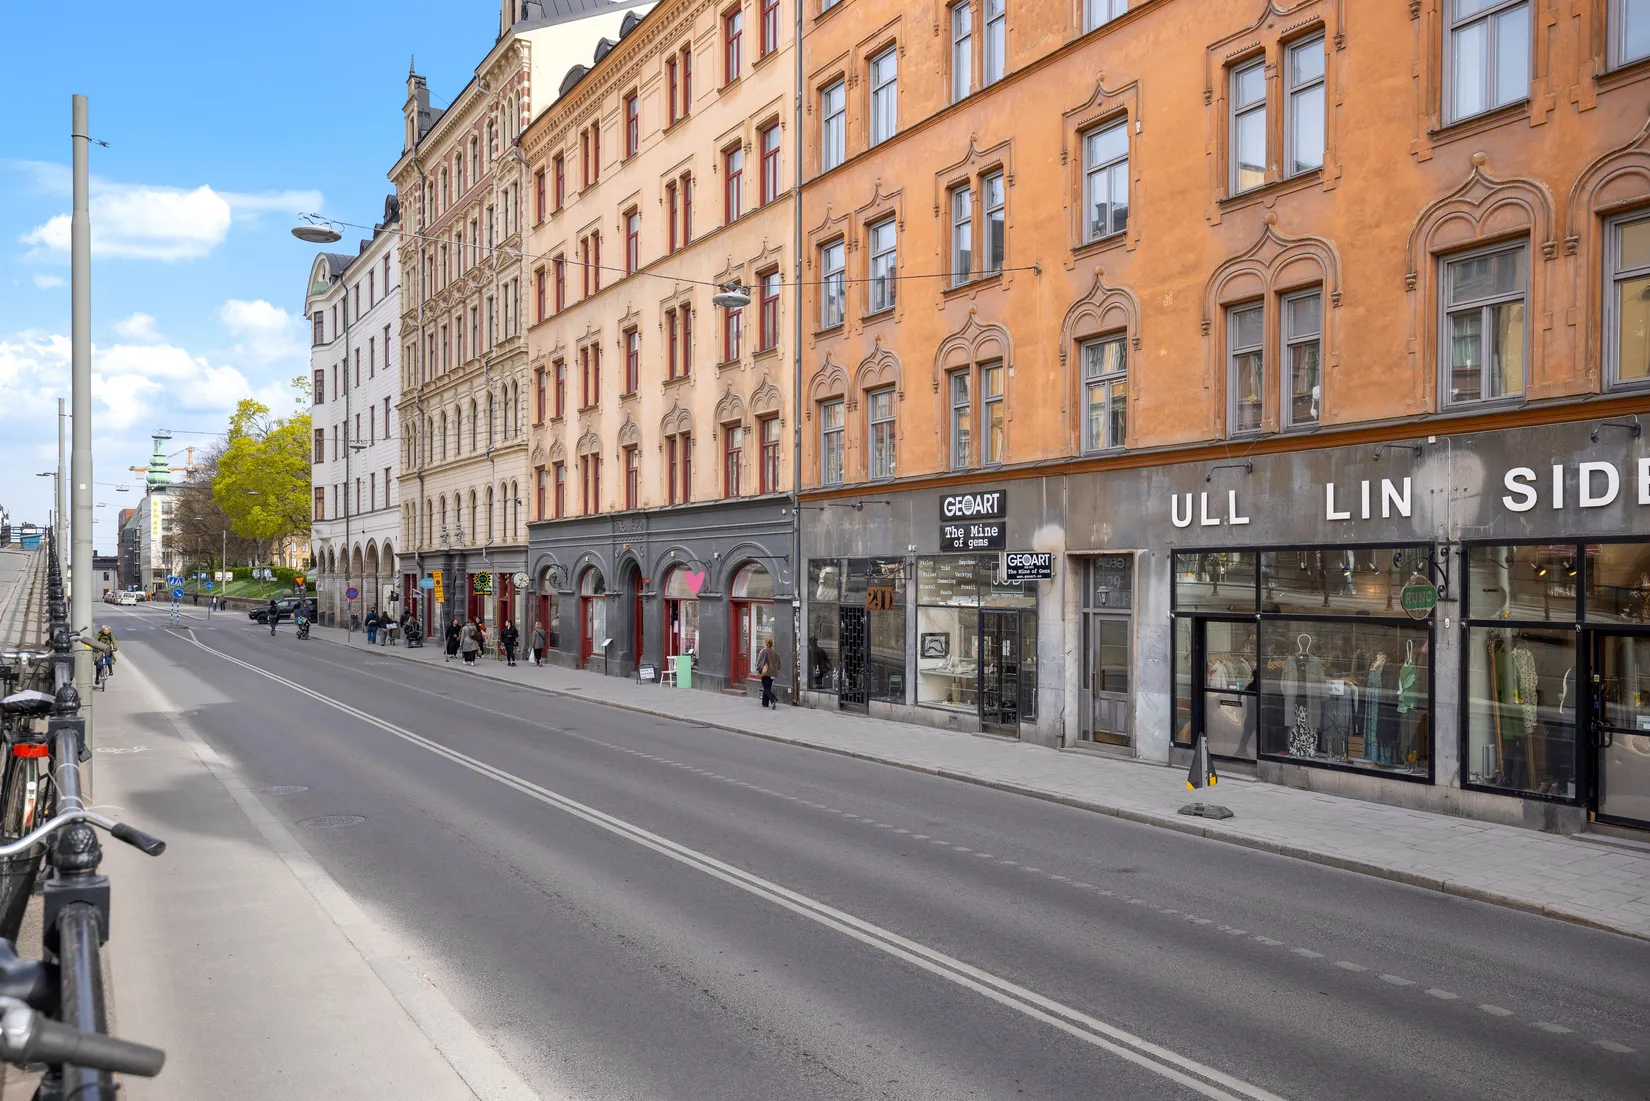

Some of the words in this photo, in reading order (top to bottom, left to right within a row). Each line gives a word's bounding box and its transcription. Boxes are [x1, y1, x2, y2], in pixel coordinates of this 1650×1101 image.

[944, 493, 1000, 516] GEOART
[1172, 490, 1250, 528] ULL
[1326, 476, 1412, 520] LIN
[945, 526, 964, 538] The
[970, 524, 998, 537] Mine
[954, 538, 963, 547] of
[968, 538, 988, 549] gems
[1008, 554, 1050, 566] GEOART
